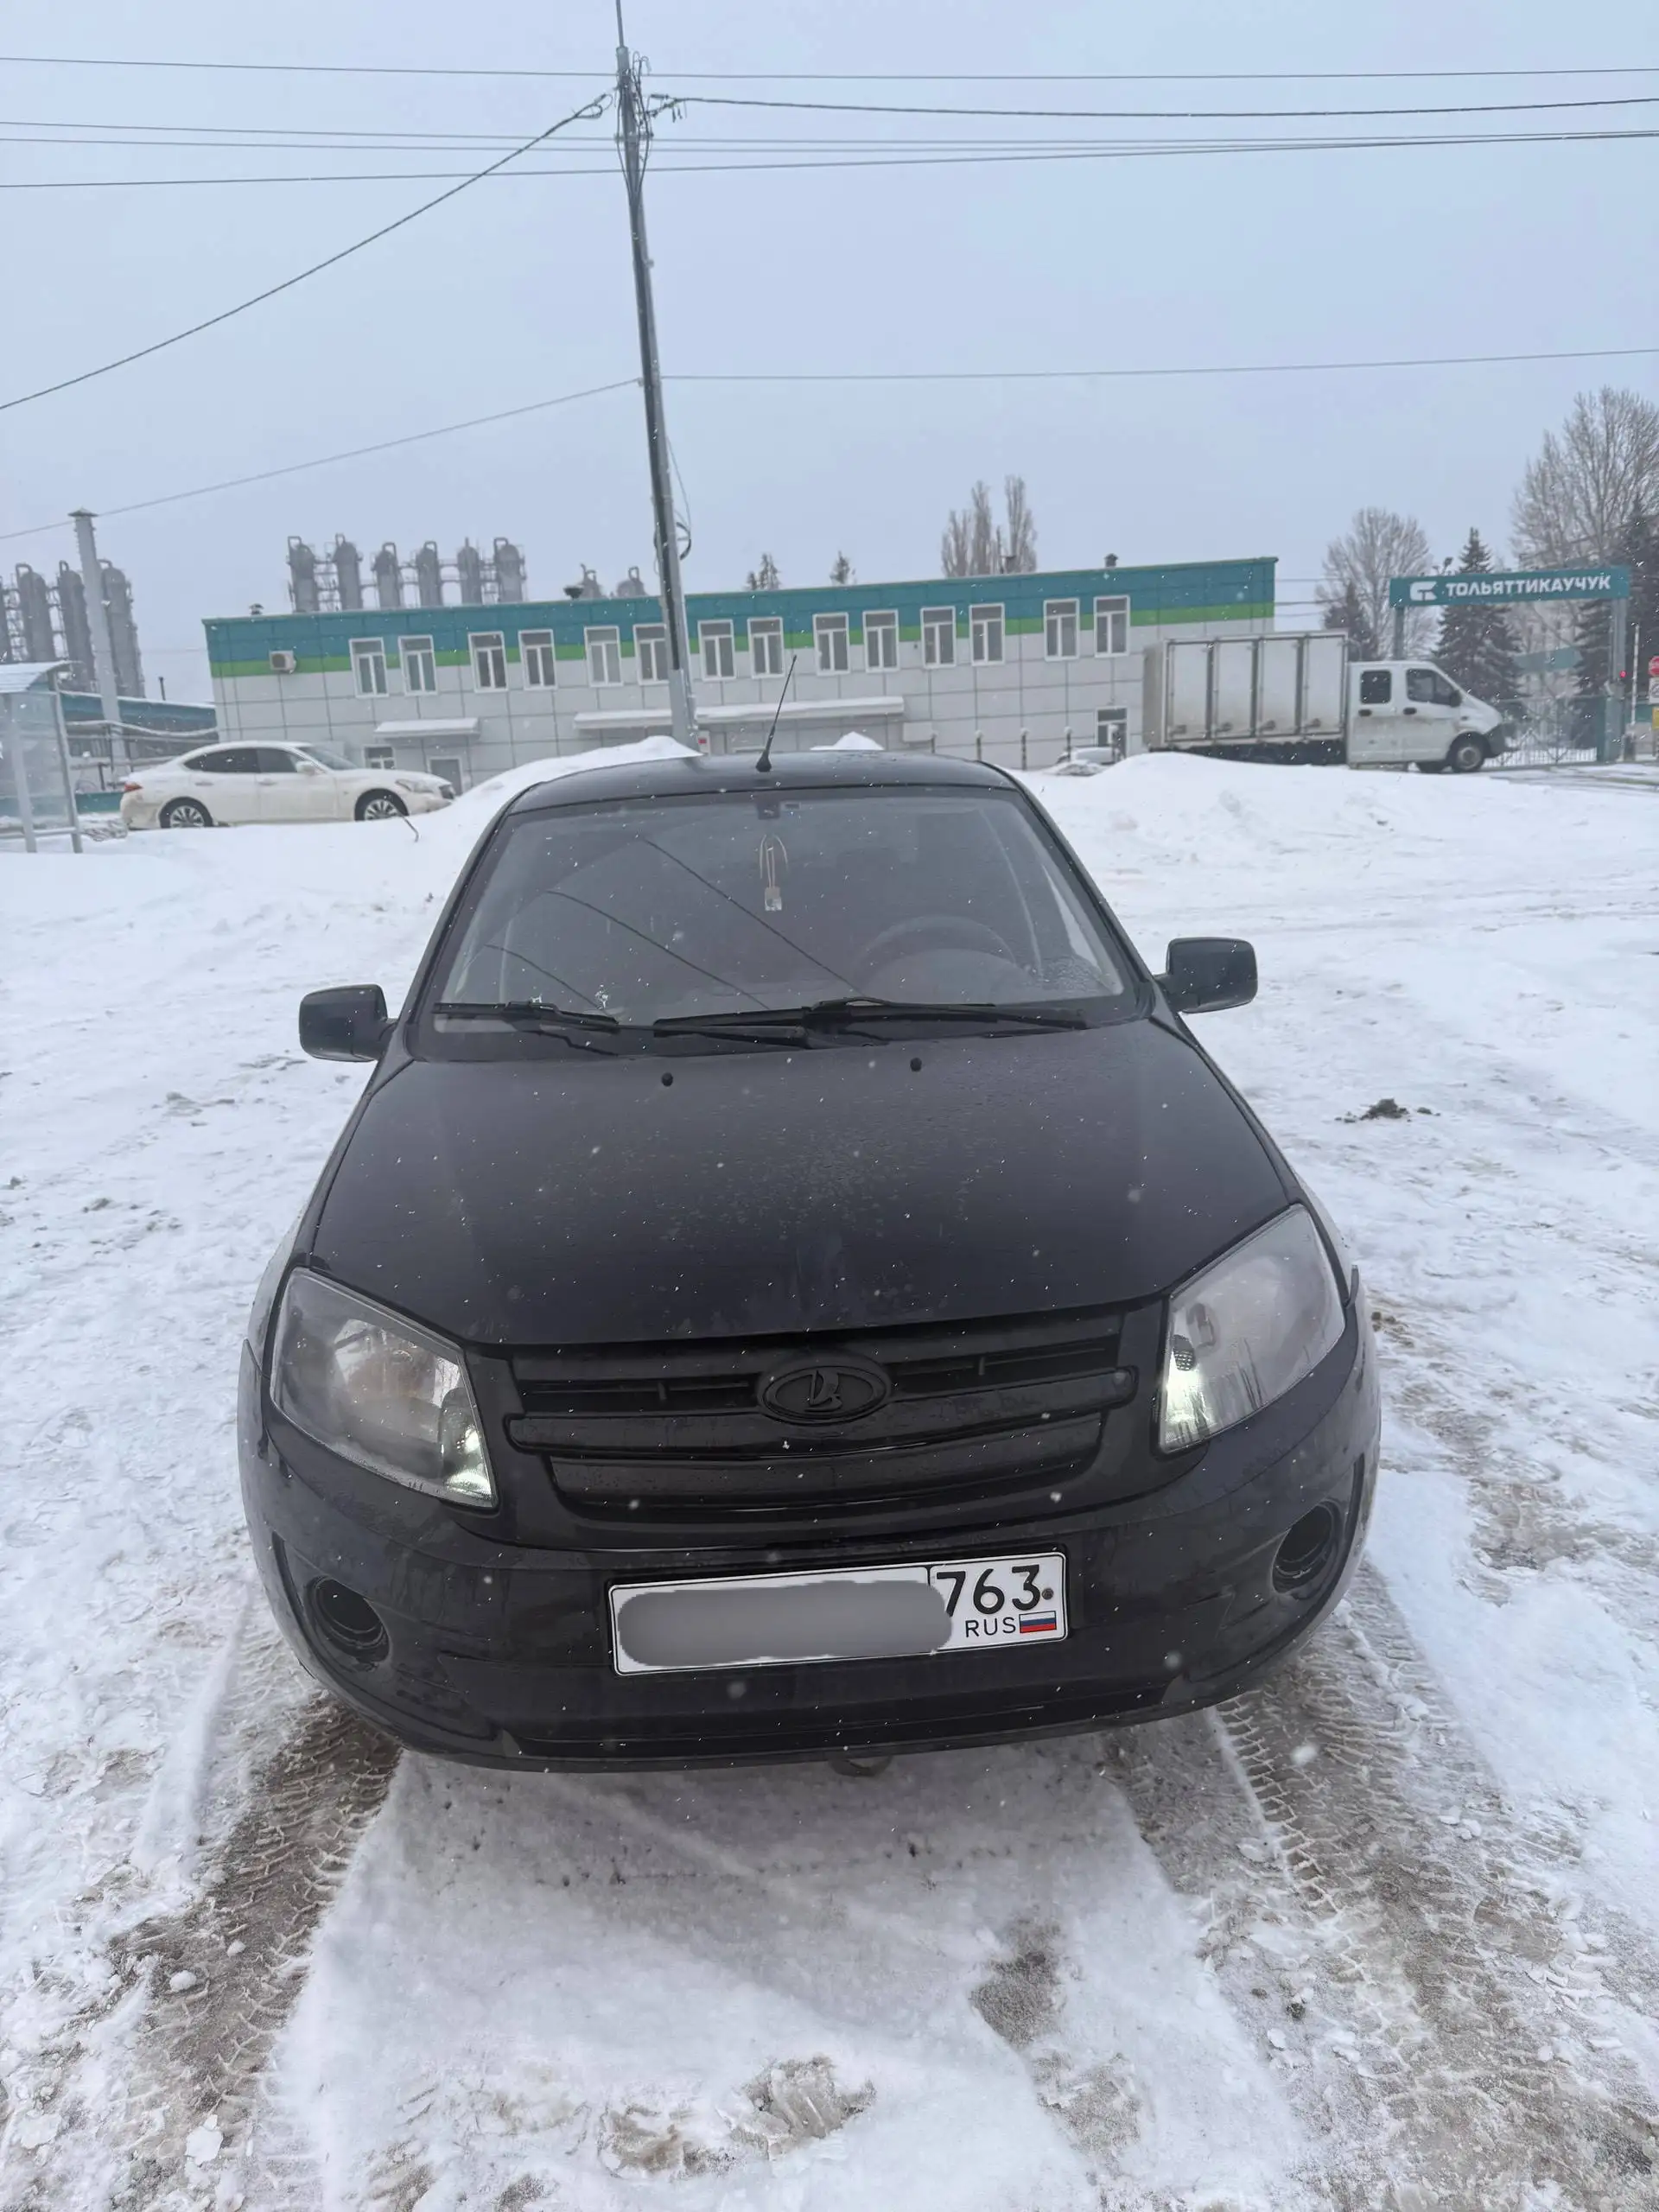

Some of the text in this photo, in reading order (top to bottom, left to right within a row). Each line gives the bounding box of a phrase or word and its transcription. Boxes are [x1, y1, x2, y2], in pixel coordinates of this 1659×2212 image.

[1446, 575, 1611, 597] ТОЛЬЯТТИКАУЧУК
[937, 1564, 1040, 1617] 763
[965, 1617, 1016, 1637] RUS
